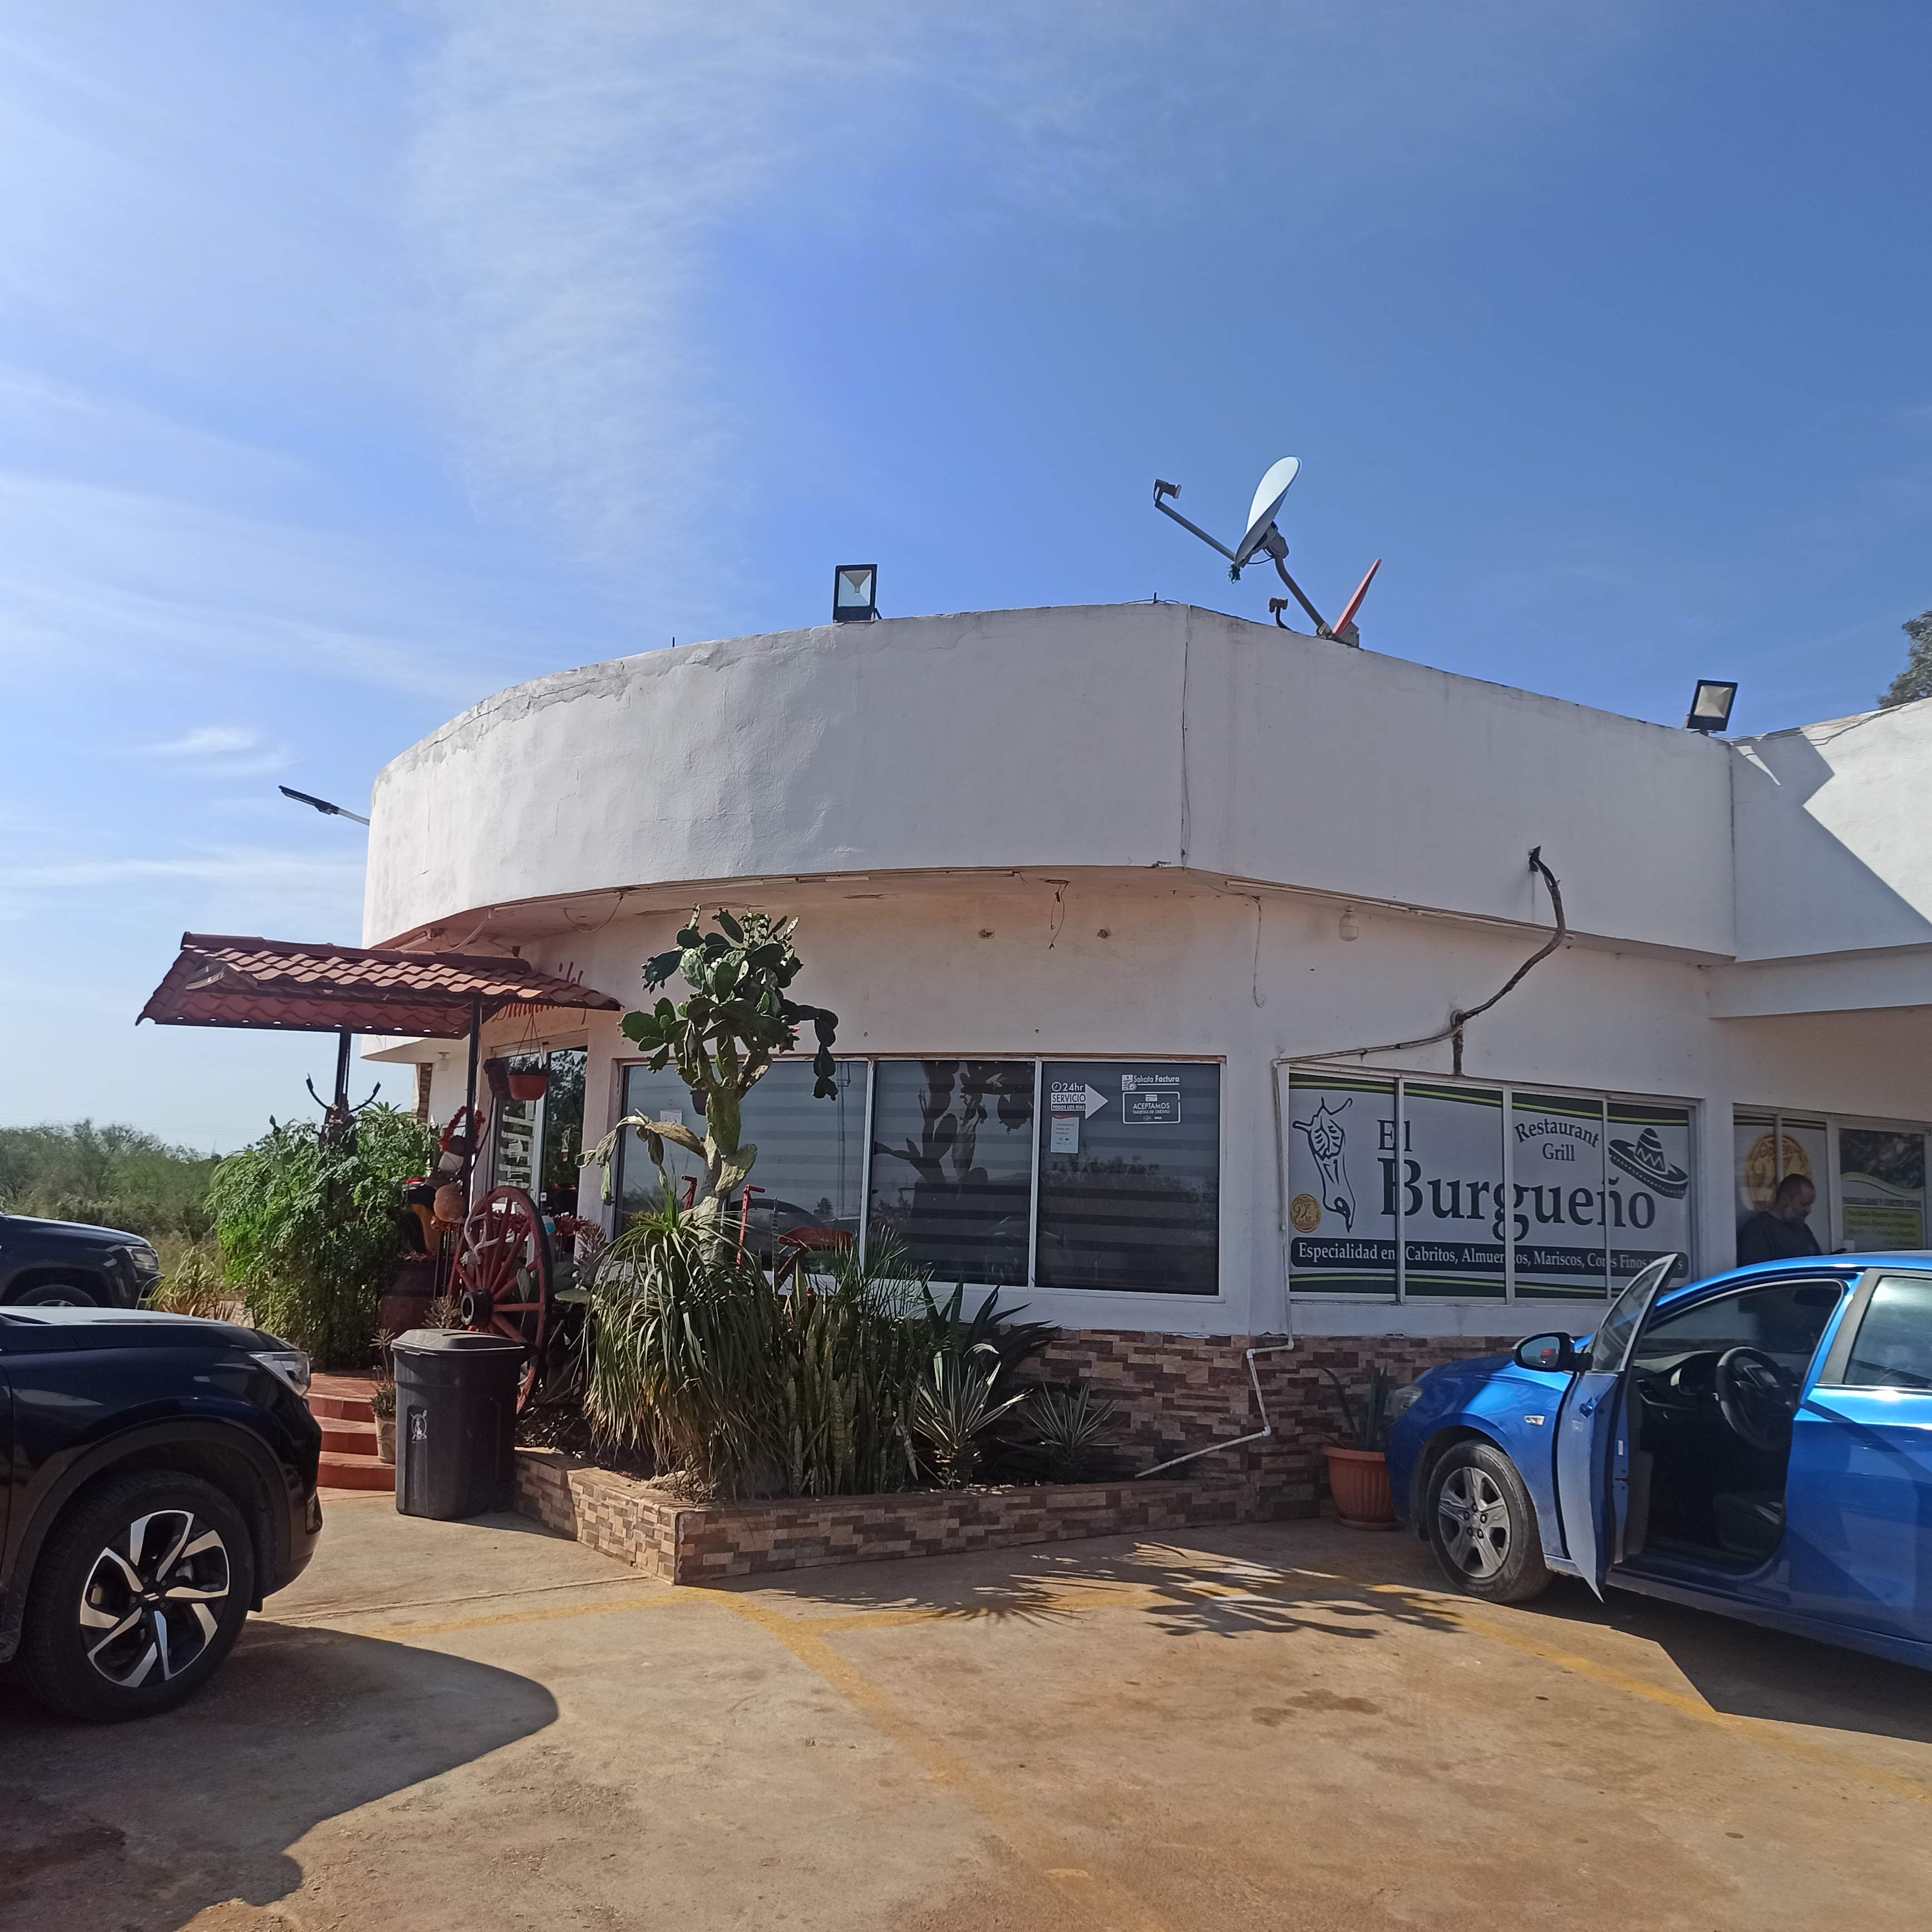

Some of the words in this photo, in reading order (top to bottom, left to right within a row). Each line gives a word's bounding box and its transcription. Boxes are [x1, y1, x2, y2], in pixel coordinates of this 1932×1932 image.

[1062, 1082, 1084, 1091] 24hr
[1133, 1075, 1154, 1083] Solicita
[1052, 1093, 1086, 1103] SERVICIO
[1377, 1120, 1412, 1152] El
[1514, 1118, 1600, 1148] Restaurant
[1542, 1143, 1575, 1161] Grill
[1377, 1157, 1655, 1241] Burgueño
[1298, 1242, 1378, 1262] Especialidad
[1382, 1249, 1396, 1260] en
[1406, 1246, 1458, 1264] Cabritos,
[1462, 1248, 1531, 1267] Almueros,
[1534, 1250, 1585, 1268] Mariscos,
[1587, 1253, 1617, 1268] Cors
[1619, 1254, 1647, 1269] Finos
